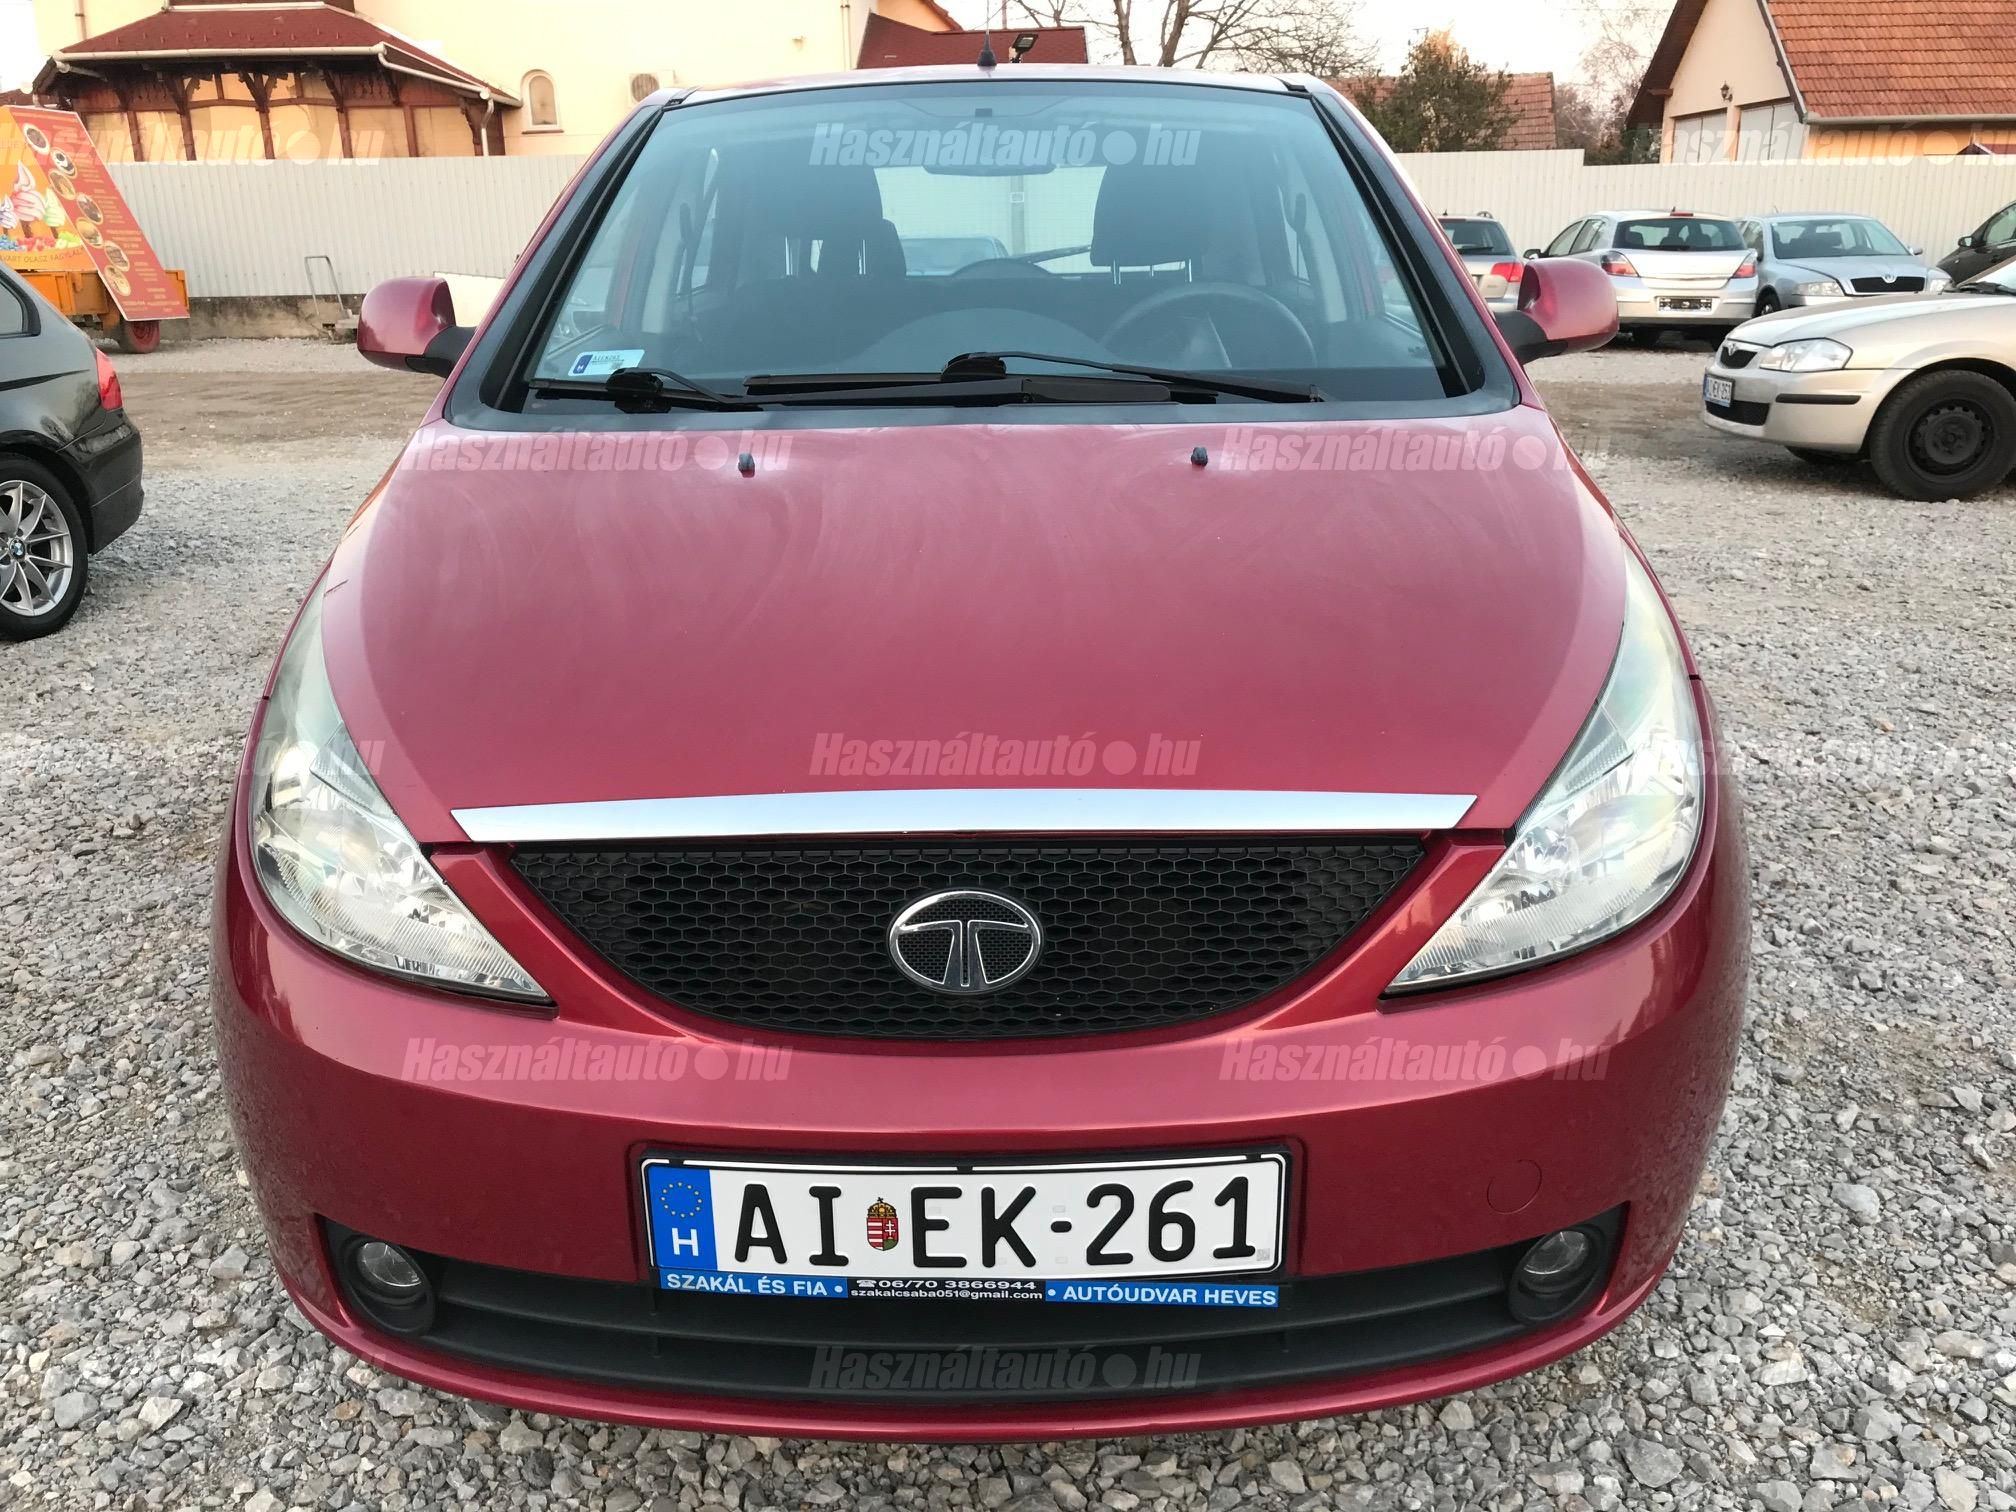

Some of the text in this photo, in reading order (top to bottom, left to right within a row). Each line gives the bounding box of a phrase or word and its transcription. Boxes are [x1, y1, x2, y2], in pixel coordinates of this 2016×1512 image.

[672, 1228, 699, 1257] H
[667, 1273, 827, 1296] SZAKÁL ÉS FIA
[850, 1288, 1043, 1299] szakalcsaba051@gmail.com
[878, 1280, 1037, 1290] 06/70 3866944
[1063, 1283, 1277, 1305] AUTÓUDVAR HEVES
